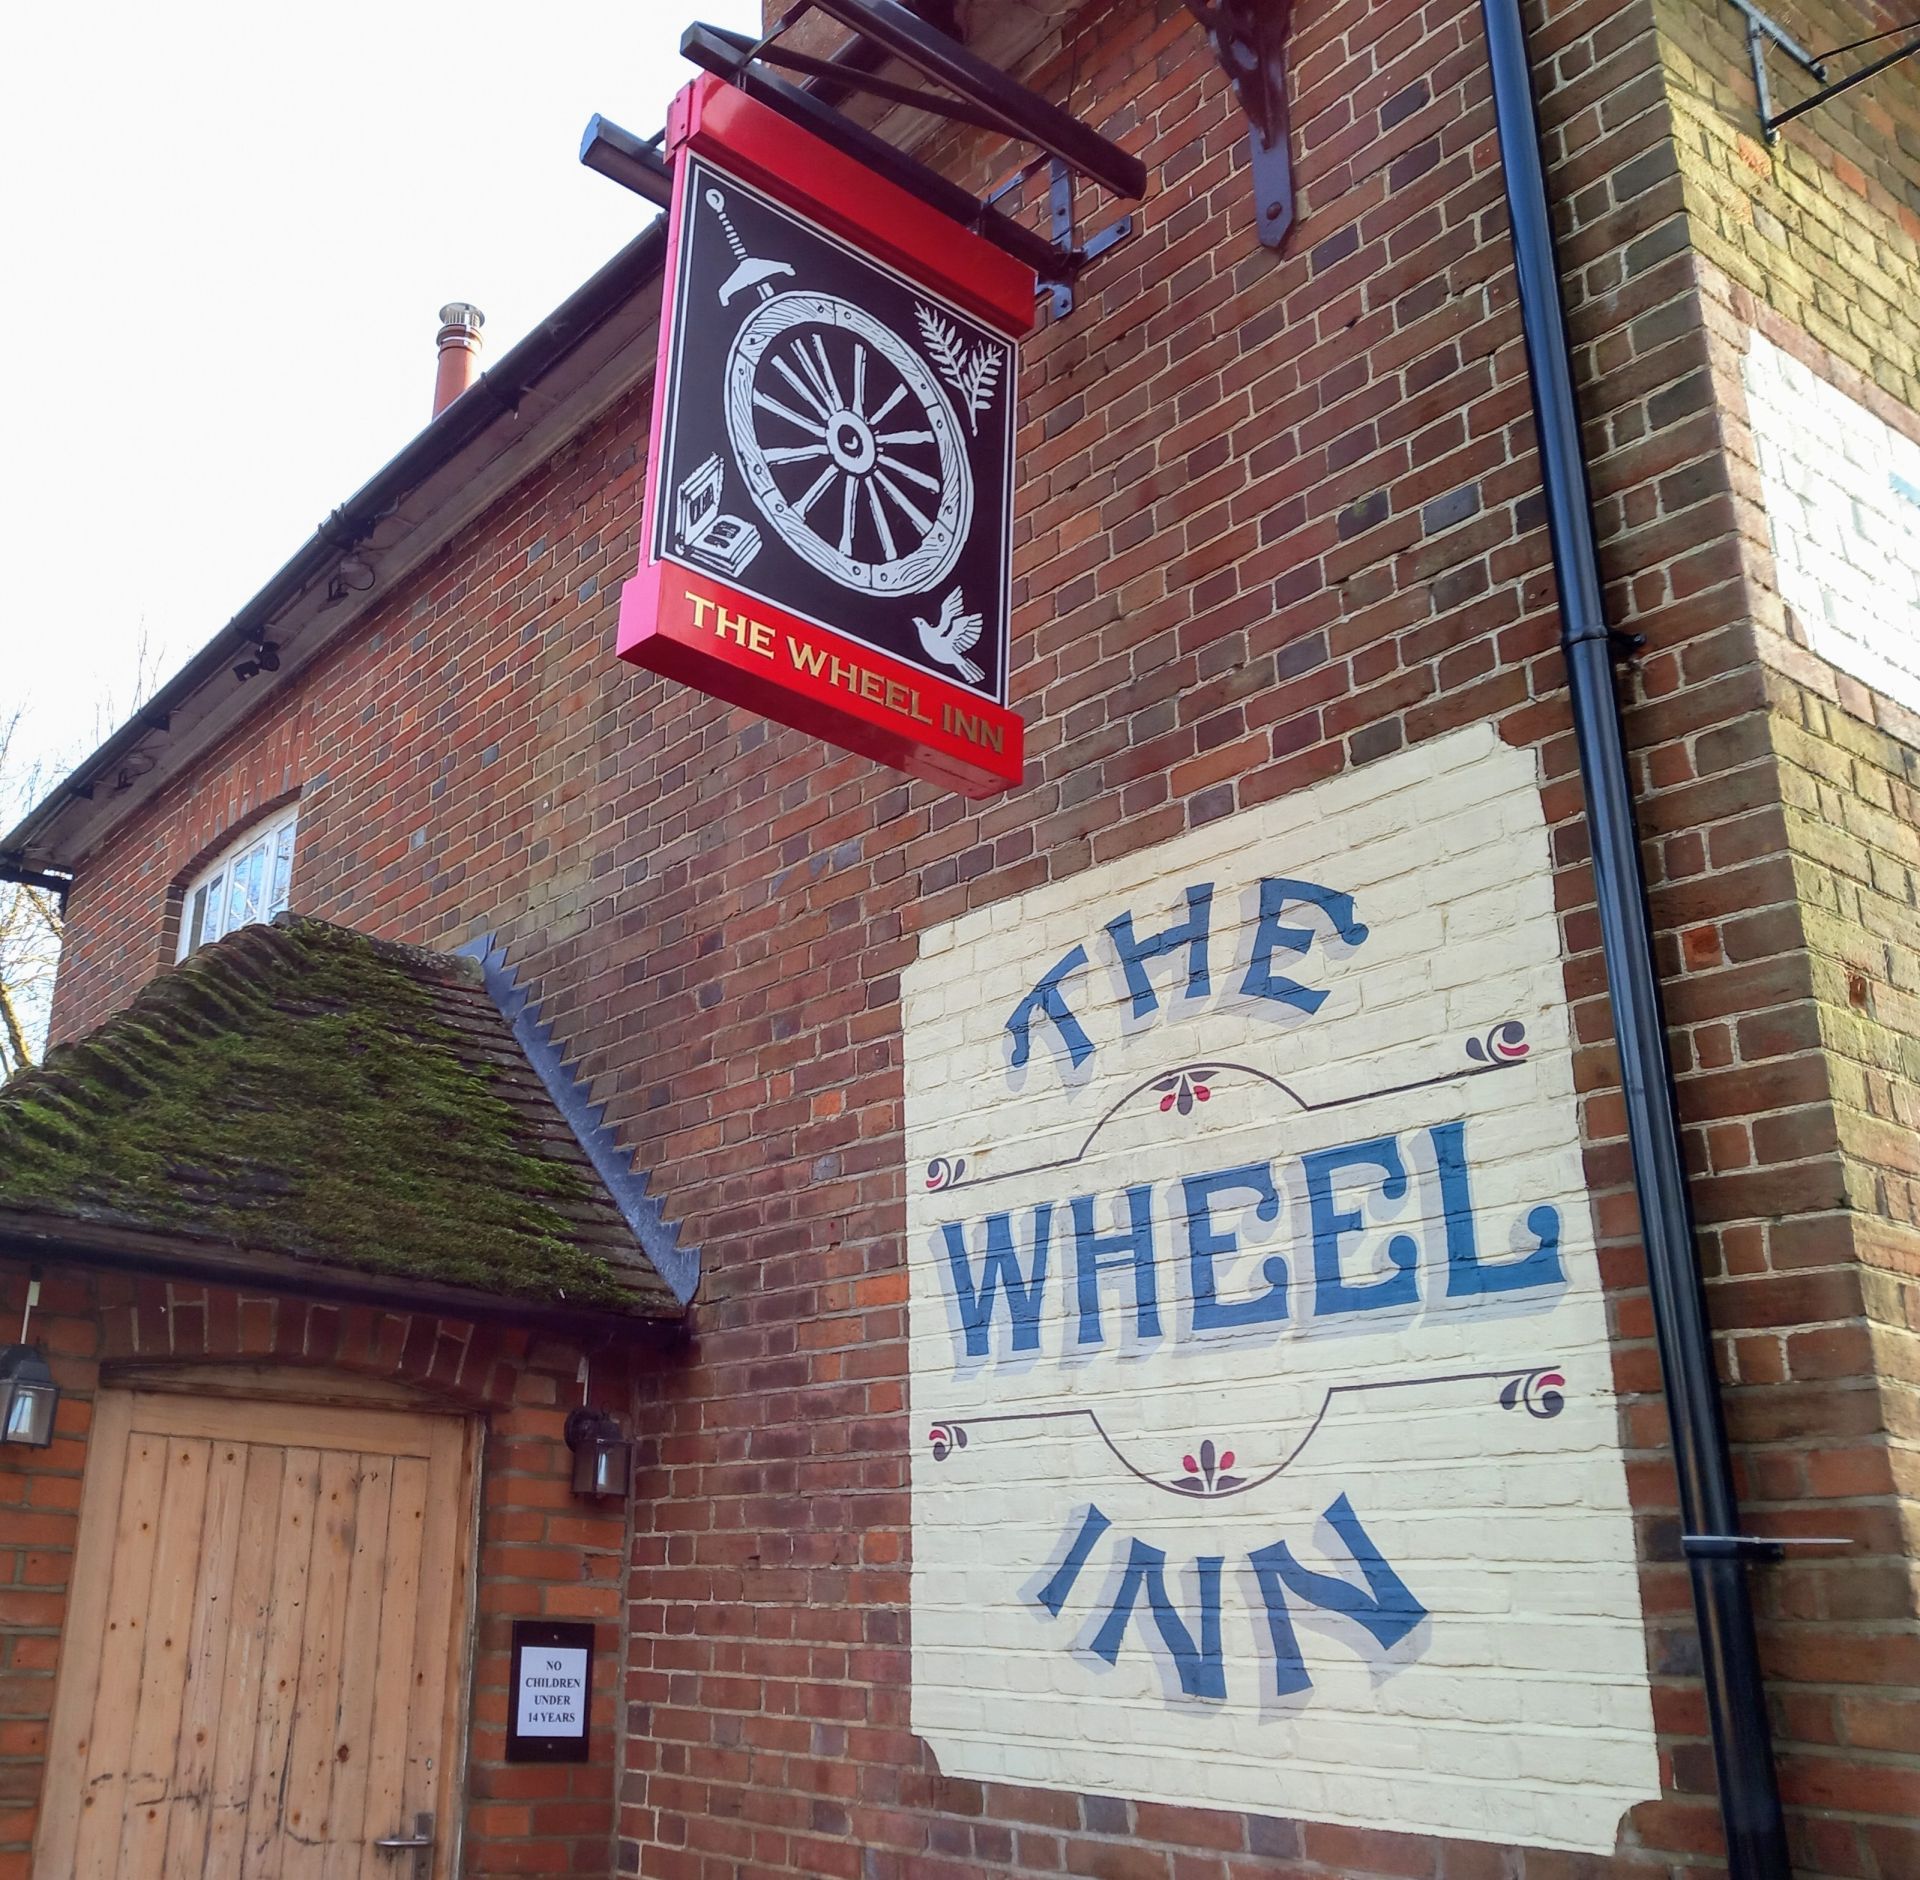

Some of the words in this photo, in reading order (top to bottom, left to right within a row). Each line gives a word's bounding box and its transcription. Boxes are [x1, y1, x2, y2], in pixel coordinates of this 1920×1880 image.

[685, 590, 776, 660] THE
[786, 635, 932, 726] WHEEL
[940, 703, 1005, 754] INN
[1004, 877, 1369, 1070] THE
[941, 1121, 1567, 1357] WHEEL
[1037, 1491, 1428, 1699] INN
[525, 1677, 581, 1688] CHILDREN
[534, 1695, 571, 1706] UNDER
[546, 1660, 562, 1671] NO
[528, 1712, 538, 1723] 14
[540, 1712, 575, 1723] YEARS
